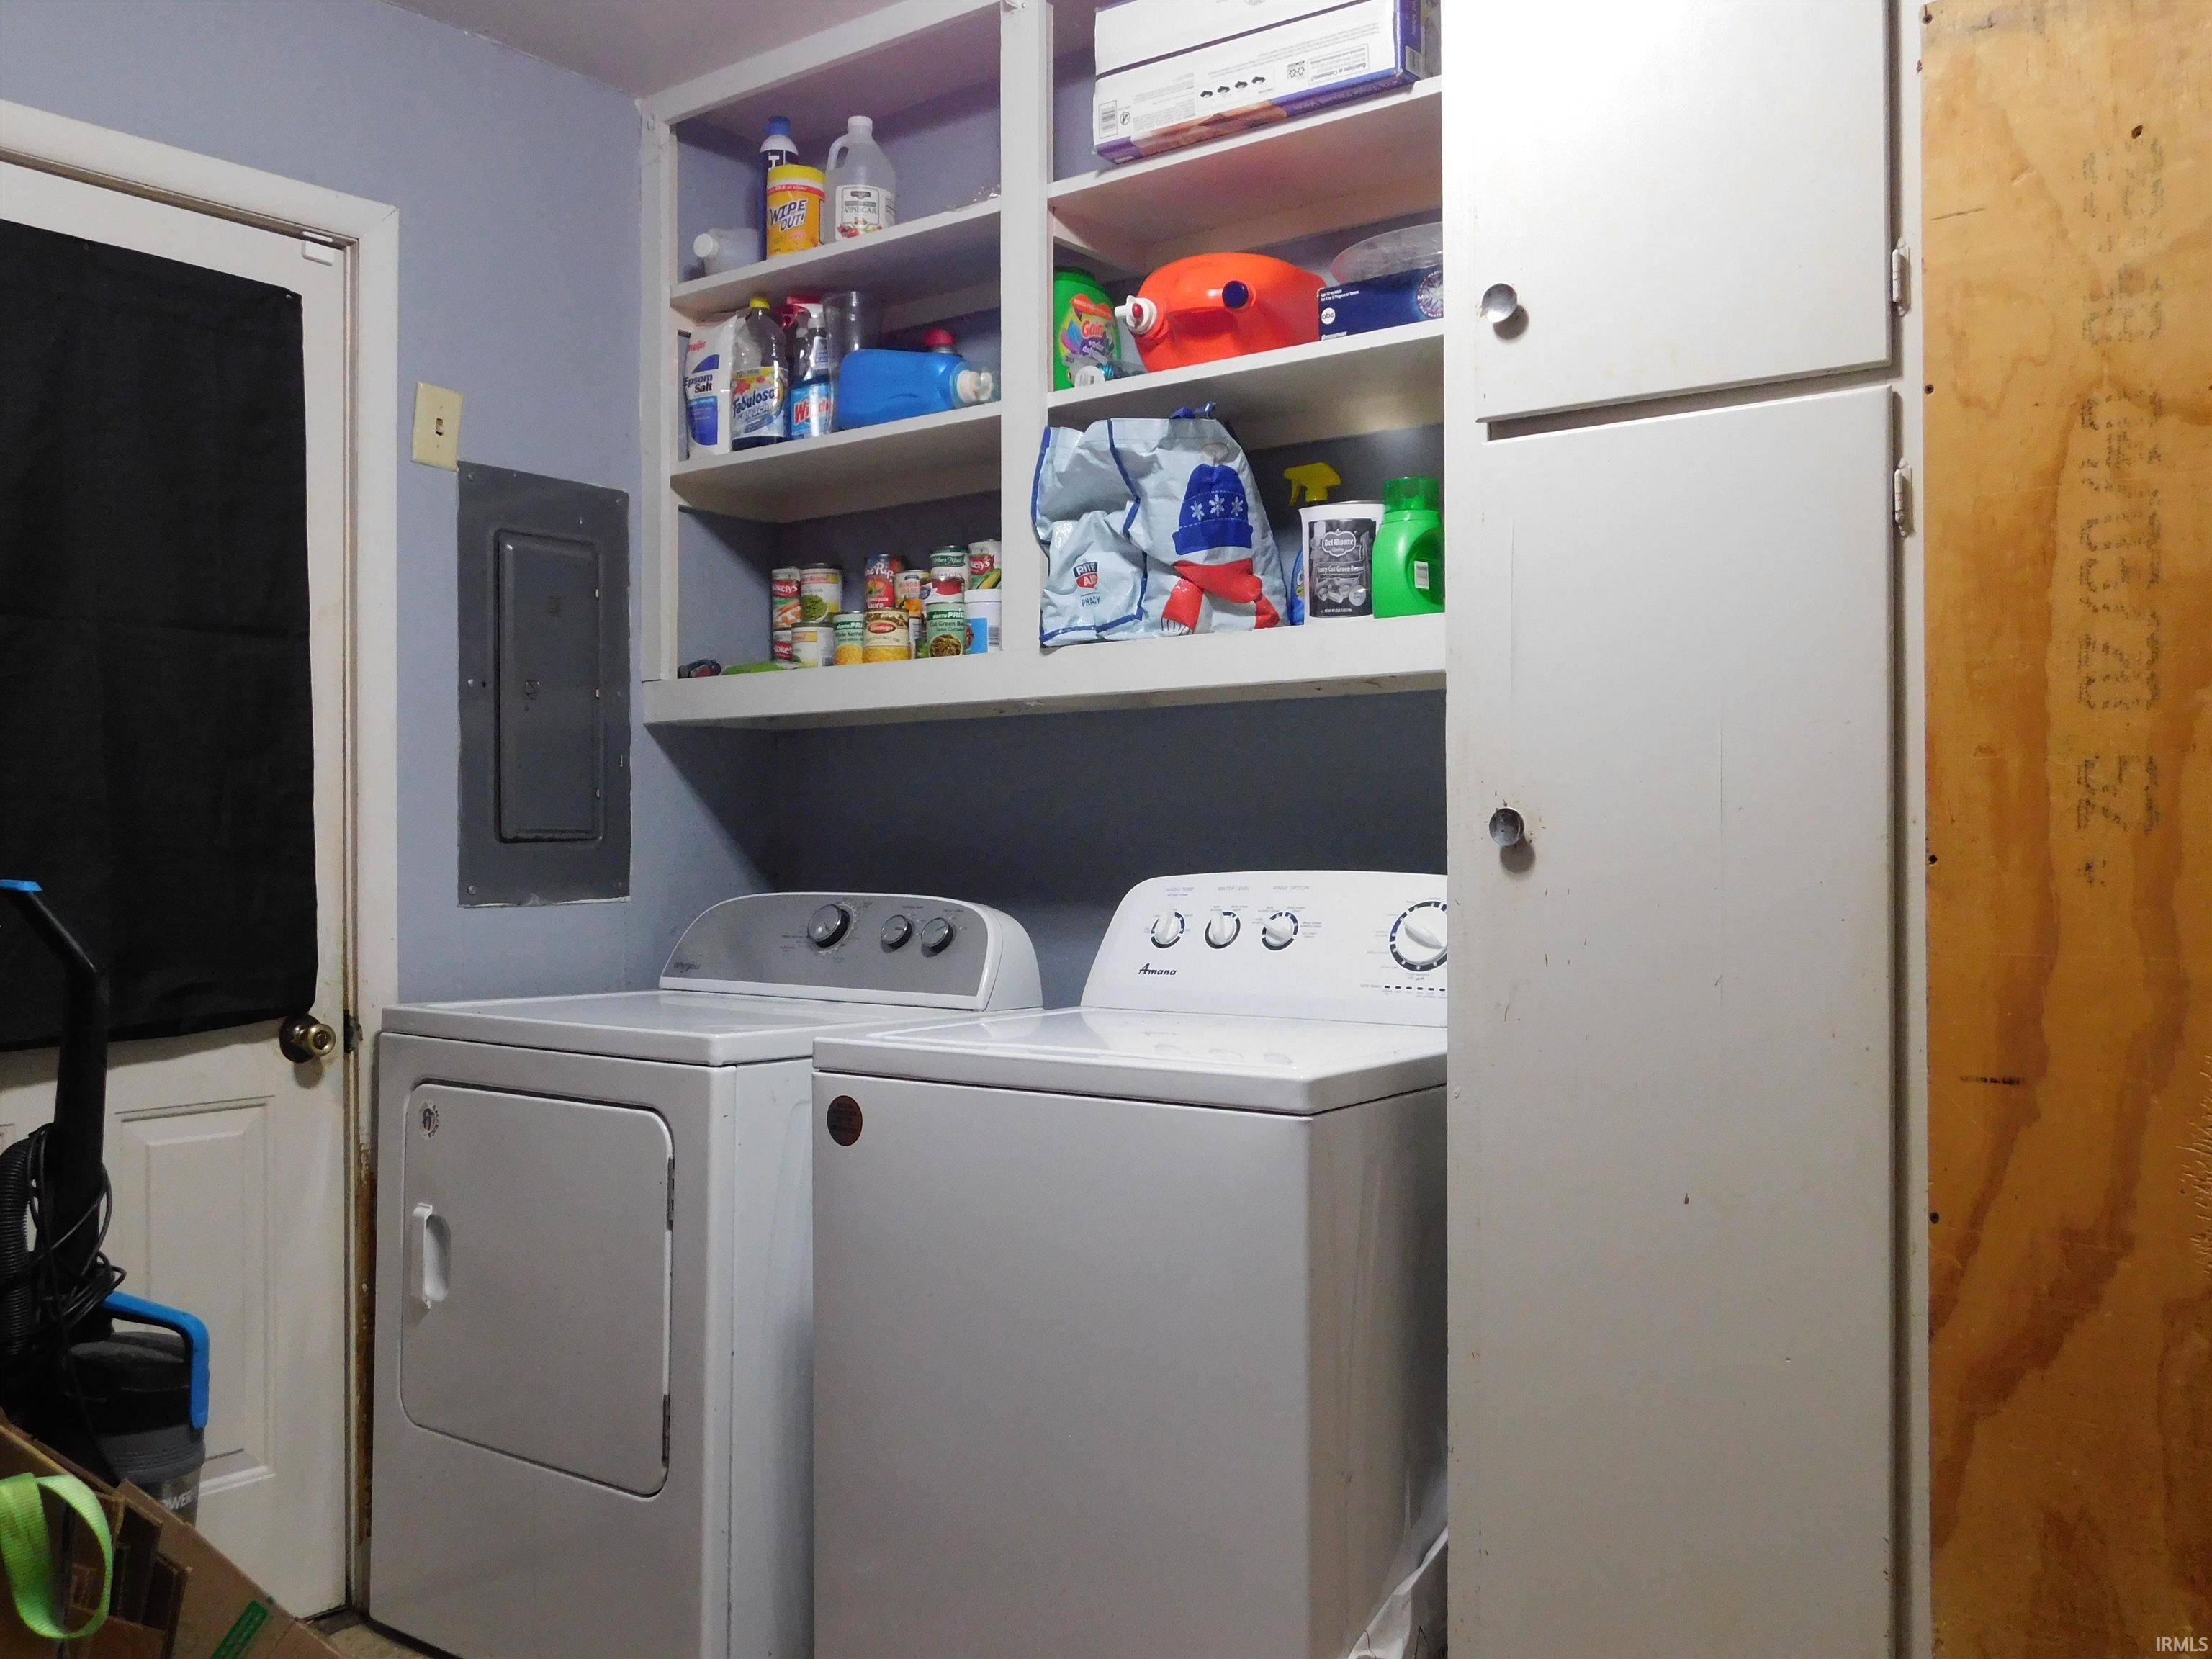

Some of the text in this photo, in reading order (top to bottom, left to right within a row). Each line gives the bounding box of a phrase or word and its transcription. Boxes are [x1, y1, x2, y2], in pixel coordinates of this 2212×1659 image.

[769, 199, 807, 225] WIPE
[845, 206, 876, 215] VINEGAR
[781, 213, 804, 231] OUT!
[1082, 320, 1103, 338] Gain
[685, 374, 713, 387] Epsom
[695, 383, 712, 393] Salt
[733, 388, 775, 418] Fabuloso
[1334, 538, 1354, 547] Monte
[874, 562, 894, 579] Rip
[1076, 563, 1095, 575] RITE
[1138, 963, 1177, 976] Amana
